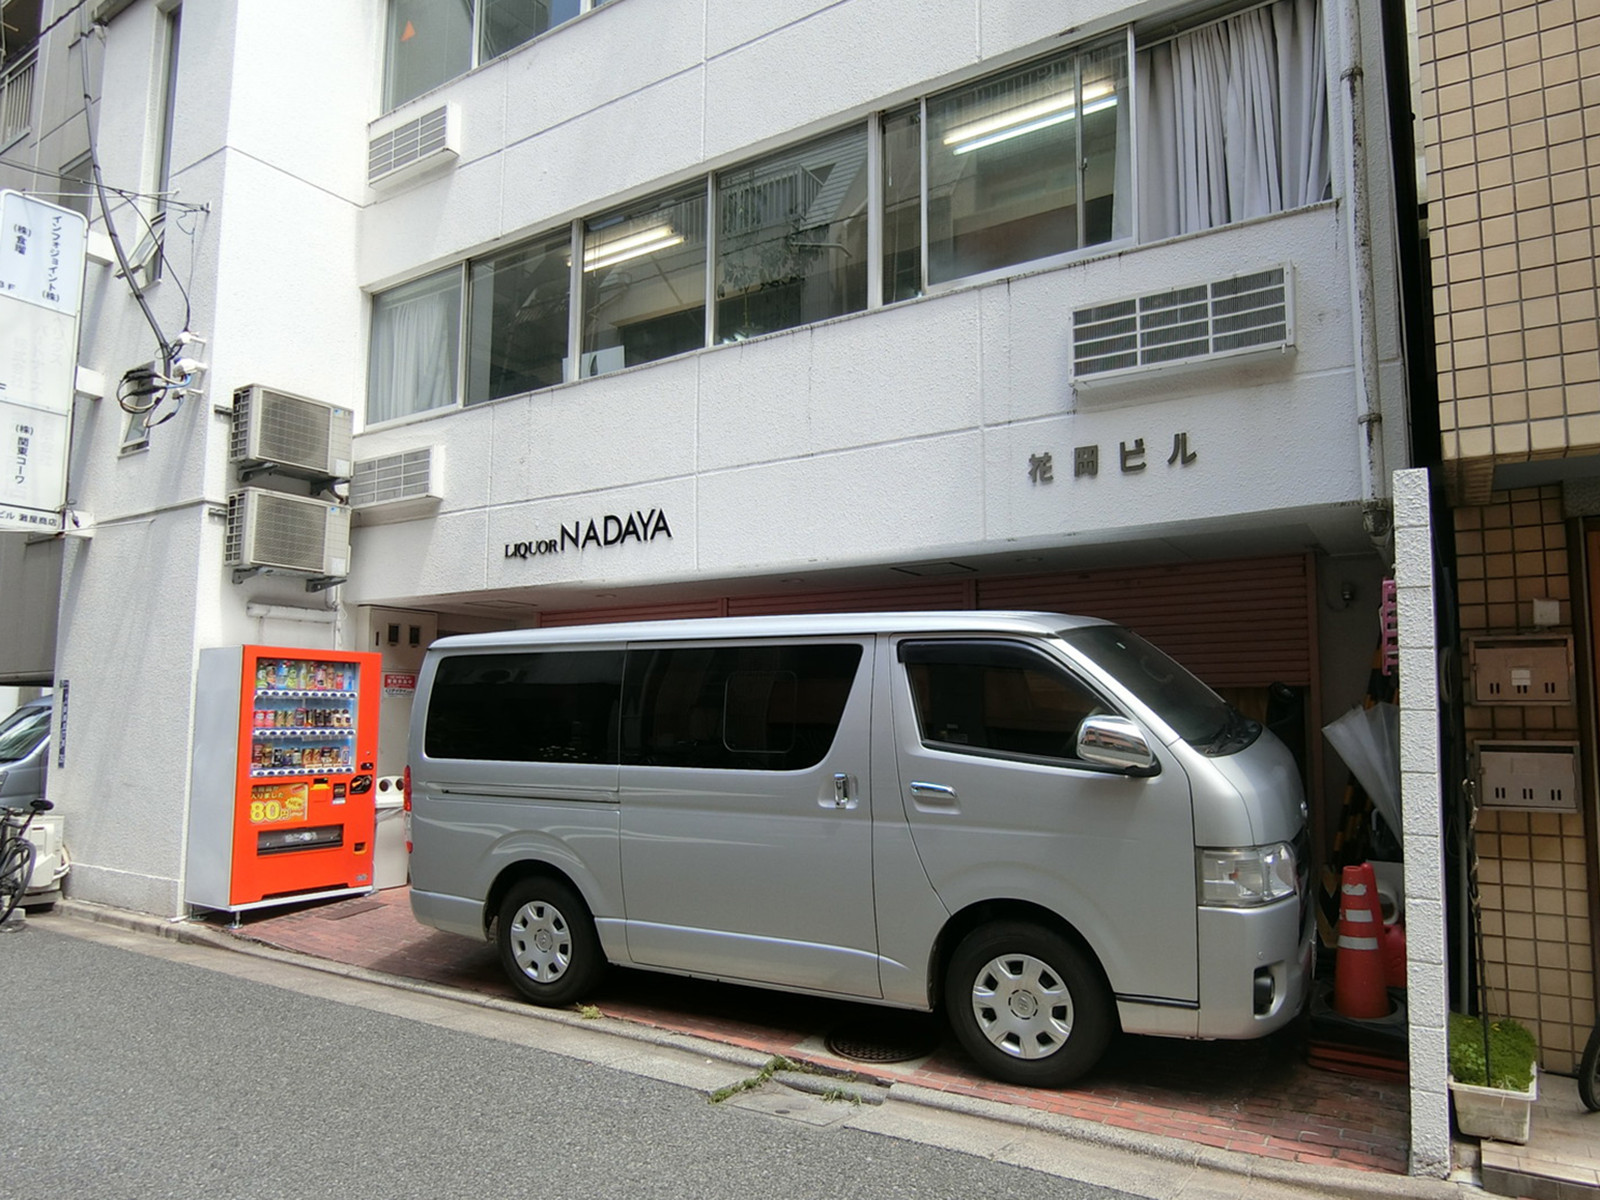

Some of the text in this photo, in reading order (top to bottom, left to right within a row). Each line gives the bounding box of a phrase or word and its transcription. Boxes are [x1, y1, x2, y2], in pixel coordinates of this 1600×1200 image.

[1028, 432, 1198, 483] 花岡ビル
[504, 508, 673, 559] LIQUOR NADAYA
